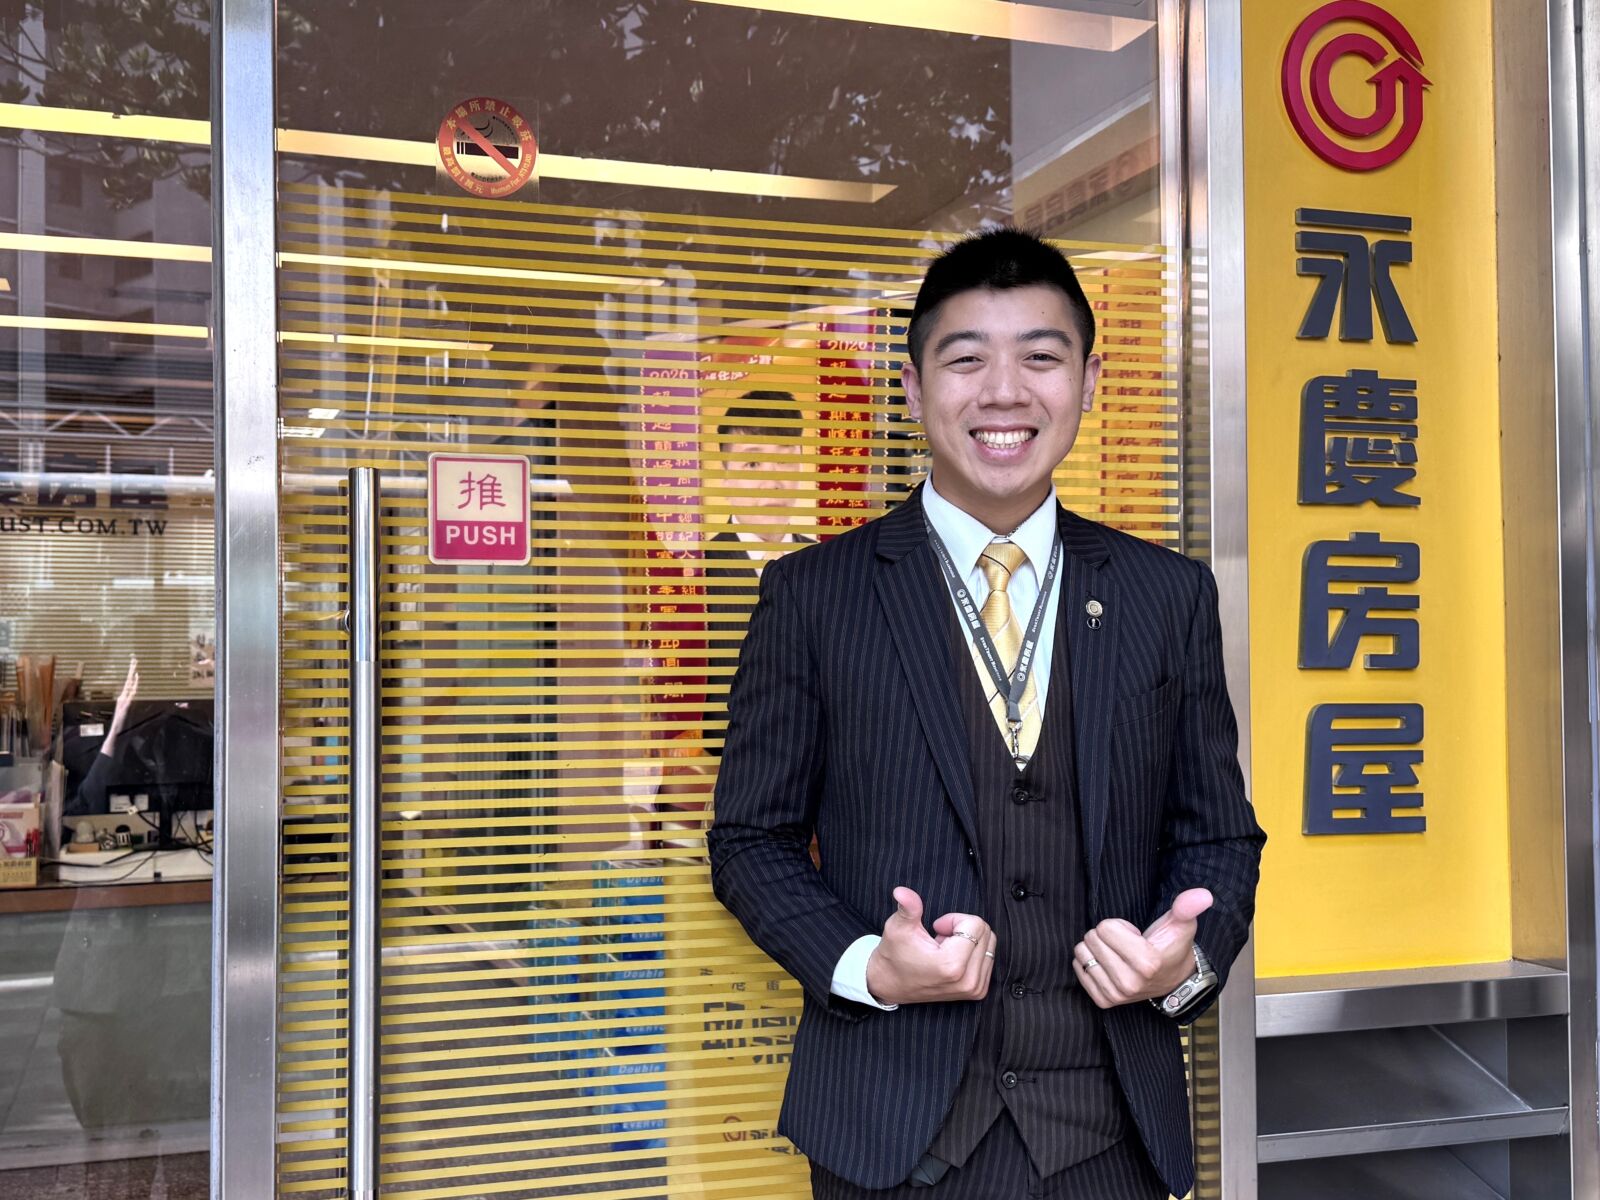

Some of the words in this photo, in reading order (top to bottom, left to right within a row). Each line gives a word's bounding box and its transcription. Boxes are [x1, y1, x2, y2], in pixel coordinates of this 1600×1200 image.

[458, 471, 506, 510] 推
[446, 525, 516, 545] PUSH
[1296, 208, 1426, 836] 永慶房屋
